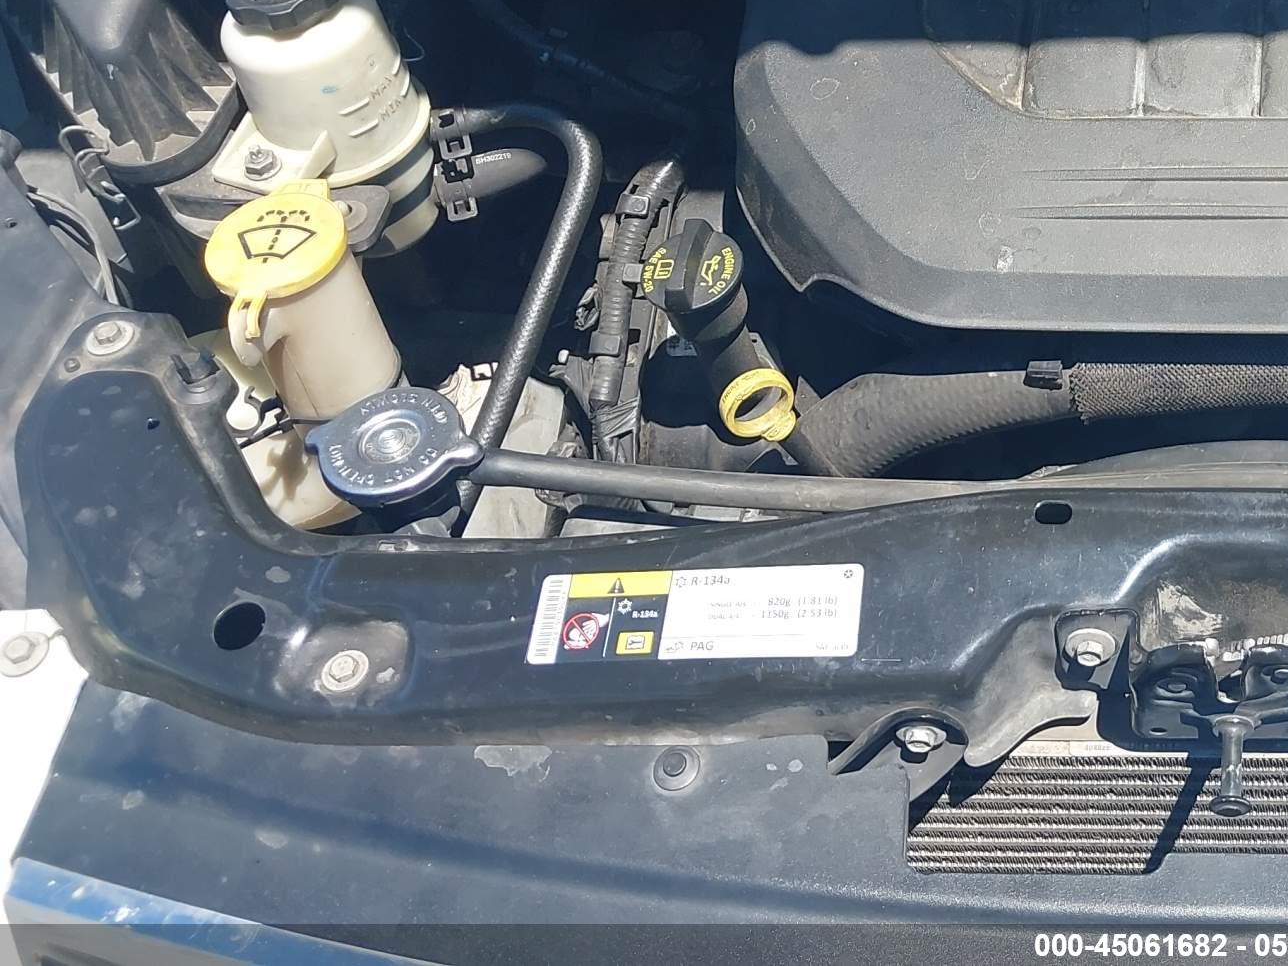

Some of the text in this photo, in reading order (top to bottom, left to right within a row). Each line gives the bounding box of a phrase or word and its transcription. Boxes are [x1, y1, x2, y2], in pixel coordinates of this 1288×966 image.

[642, 246, 667, 293] SAE 5W-20
[707, 246, 735, 295] ENGINE OIL
[419, 448, 437, 464] DO
[690, 576, 731, 586] R-134a
[767, 596, 791, 607] 820g
[761, 609, 790, 620] 1150g
[690, 641, 715, 651] PAG
